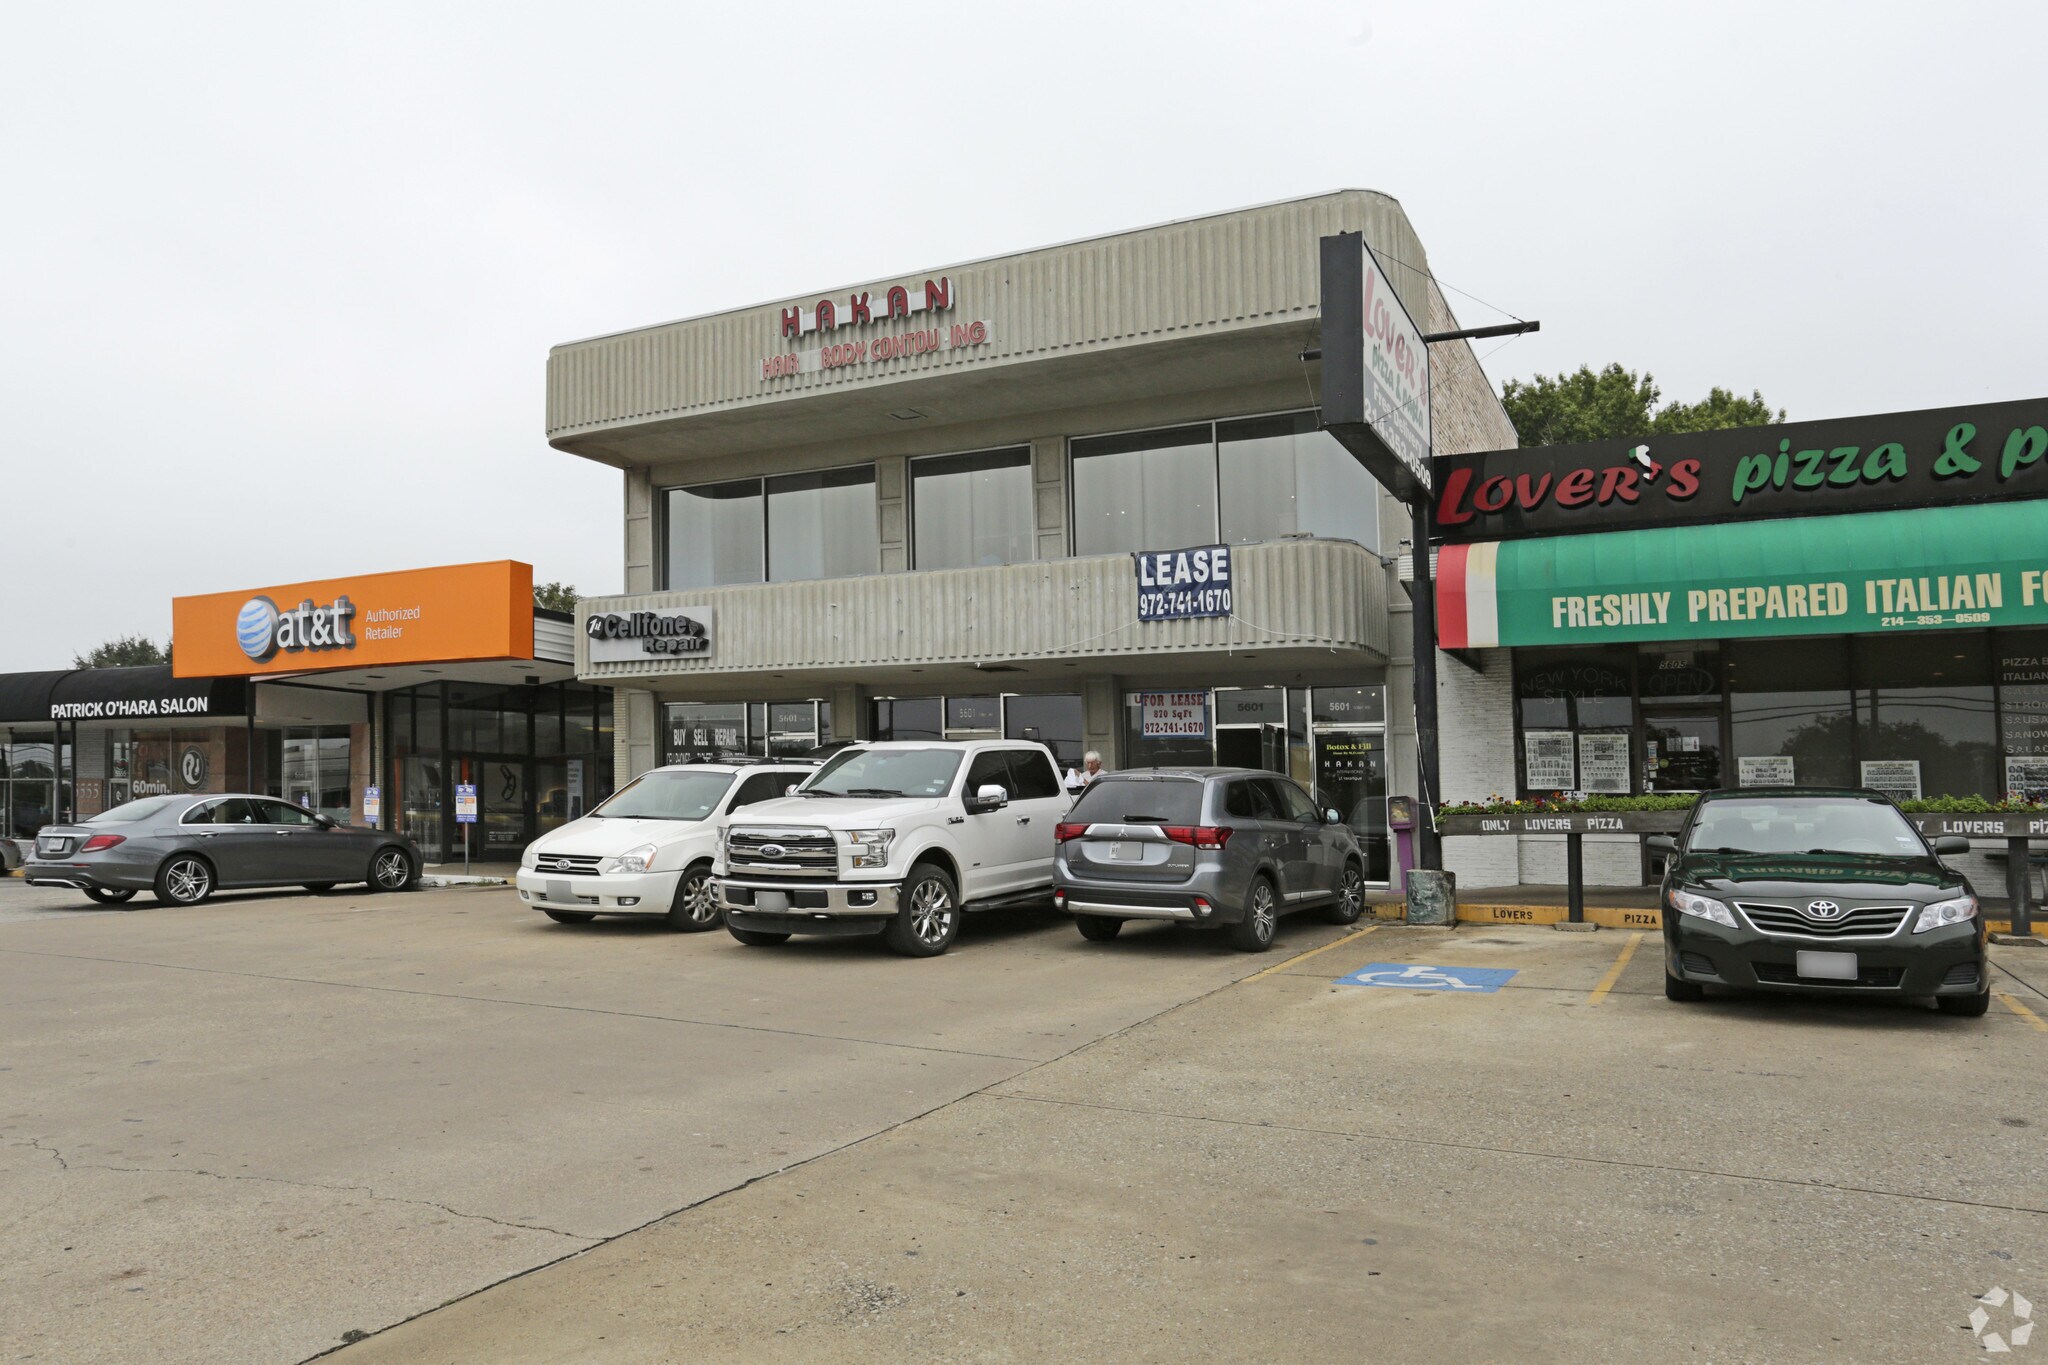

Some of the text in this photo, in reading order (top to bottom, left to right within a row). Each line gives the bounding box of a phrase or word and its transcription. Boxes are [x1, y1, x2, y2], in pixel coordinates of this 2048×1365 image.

[782, 276, 953, 338] HAKAN
[762, 353, 799, 379] HAIR
[821, 340, 867, 369] BODY
[1373, 381, 1423, 460] Free Delivery
[1364, 398, 1432, 490] 214-353-0509
[1732, 438, 1908, 502] pizza
[1934, 422, 1982, 476] &
[2001, 425, 2048, 478] p
[1140, 548, 1228, 587] LEASE
[1140, 588, 1231, 616] 972-741-1670
[1552, 570, 2048, 628] FRESHLY PREPARED ITALIAN F
[276, 599, 420, 648] at&t Authorized
[604, 612, 688, 638] Cellfone
[365, 626, 404, 641] Retailer
[643, 637, 706, 653] Repair
[1659, 660, 1687, 669] 5605
[2003, 656, 2048, 666] PIZZA B
[1521, 667, 1626, 695] NEW YORK
[1544, 688, 1603, 704] STYLE
[2004, 685, 2048, 695] CALZO
[1143, 694, 1165, 707] FOR
[1170, 692, 1203, 706] LEASE
[1238, 702, 1264, 711] 5601
[1329, 702, 1350, 711] 5601
[51, 696, 208, 719] PATRICK O'HARA SALON
[960, 708, 976, 718] 5601
[779, 714, 798, 722] 5601
[2005, 715, 2048, 724] SAUSA
[1145, 722, 1204, 733] 972-741-1670
[2005, 730, 2048, 739] SANDW
[674, 728, 736, 745] BUY SELL REPAIR
[1326, 743, 1349, 751] Botox
[1324, 760, 1376, 768] HAKAN
[132, 779, 170, 794] 60min.
[1482, 819, 1510, 831] ONLY
[1524, 818, 1571, 830] LOVERS
[1943, 820, 2004, 833] LOVERS
[1493, 909, 1533, 920] LOVERS
[1624, 914, 1657, 924] PIZZA
